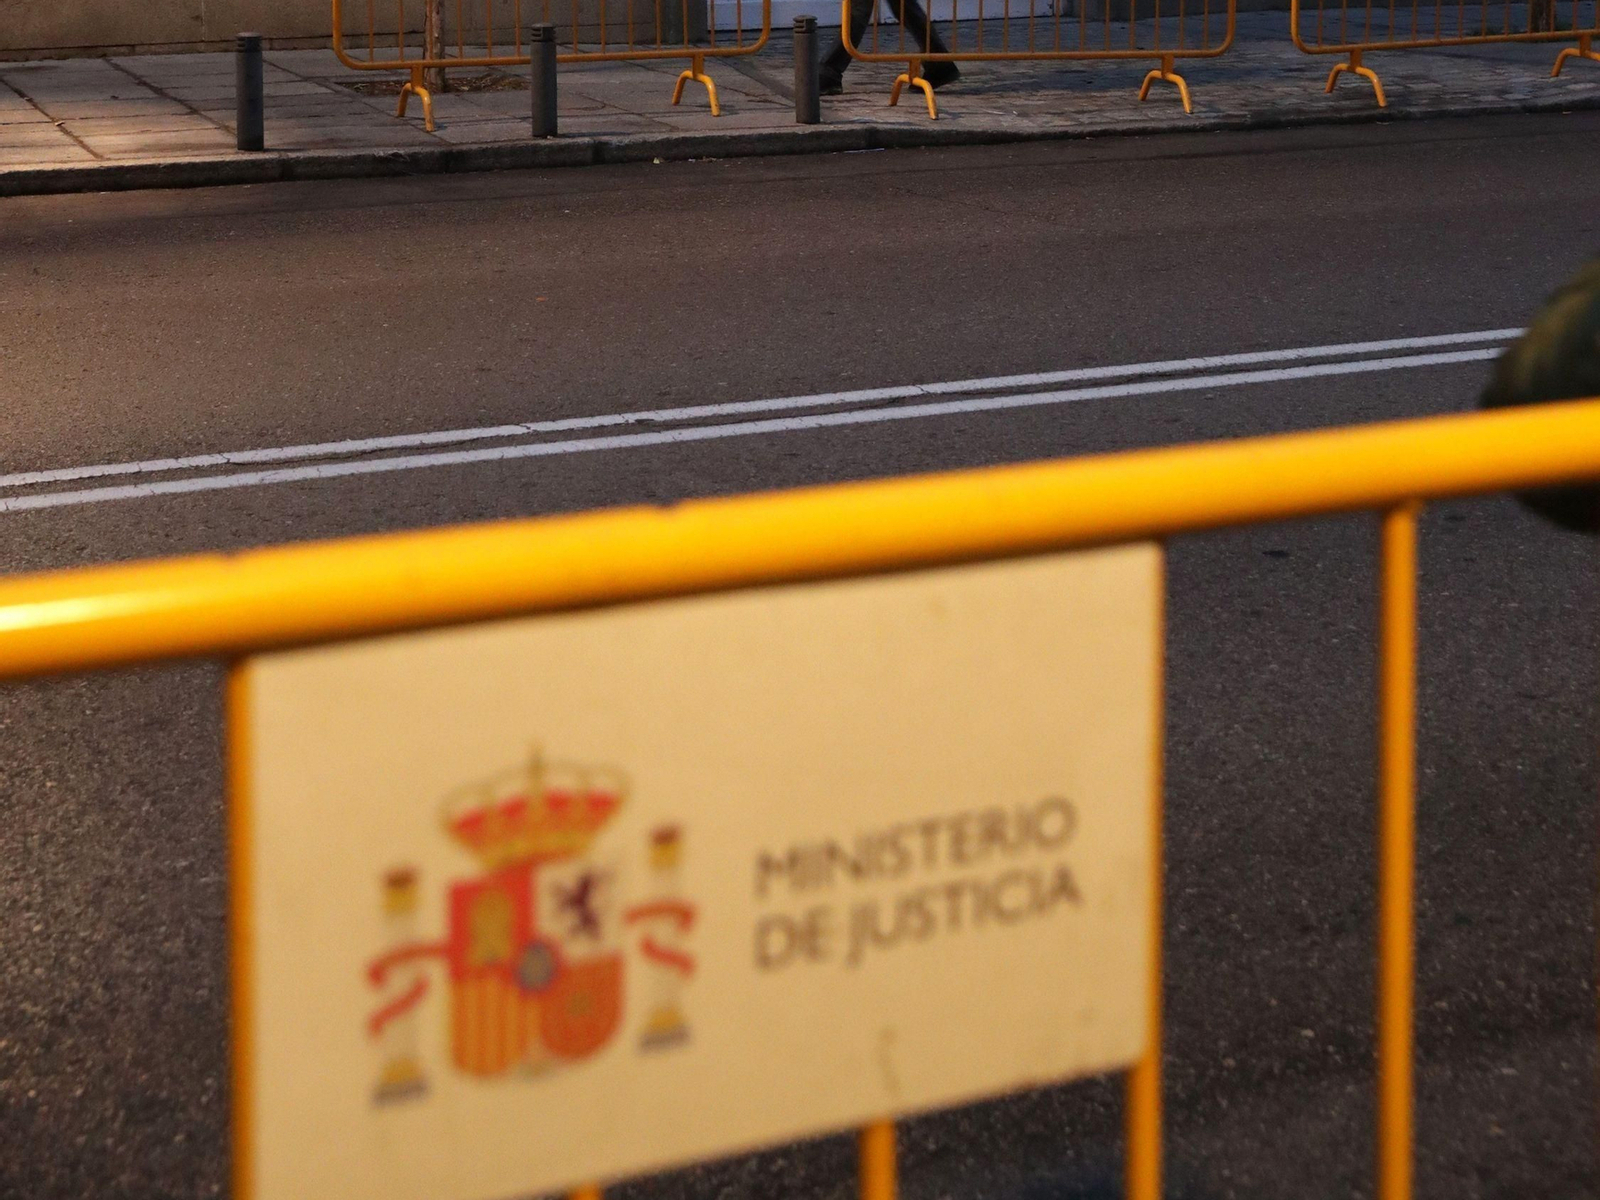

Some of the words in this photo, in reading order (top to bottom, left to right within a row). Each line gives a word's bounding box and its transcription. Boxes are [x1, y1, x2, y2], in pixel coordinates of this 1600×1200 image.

[756, 796, 1077, 898] MINISTERIO
[755, 906, 832, 972] DE
[846, 863, 1083, 969] JUSTICIA
